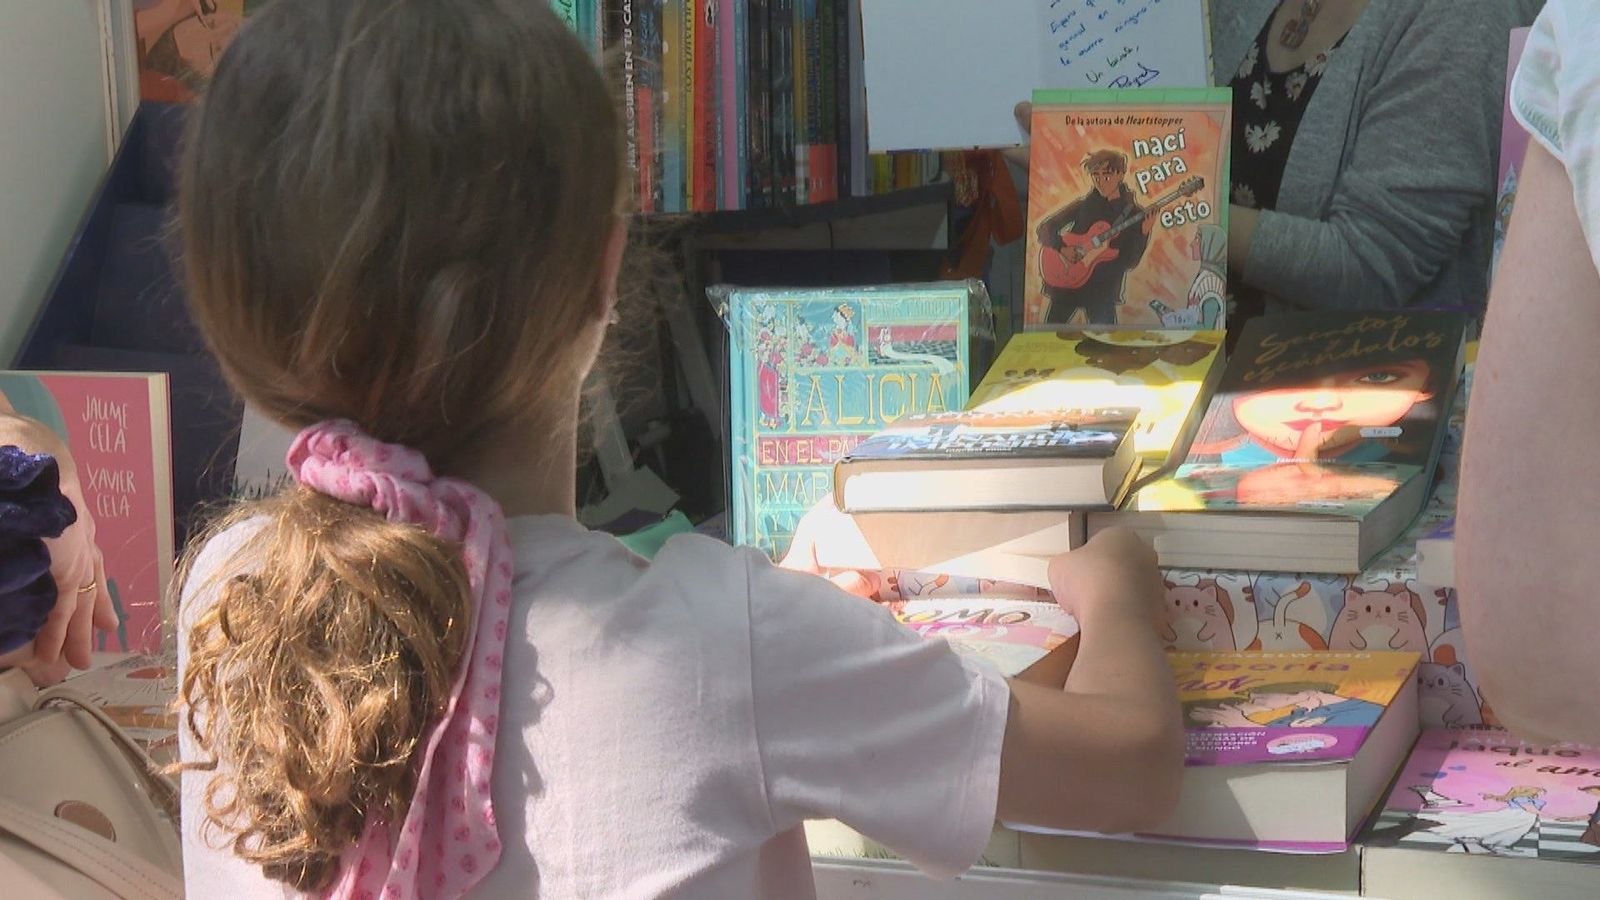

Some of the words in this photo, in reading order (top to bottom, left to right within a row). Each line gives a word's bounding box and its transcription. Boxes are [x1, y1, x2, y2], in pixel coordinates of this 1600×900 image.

[622, 0, 633, 26] CA
[623, 27, 633, 47] TU
[624, 50, 634, 71] EN
[625, 74, 636, 137] ALGUIEN
[1065, 115, 1076, 126] De
[1077, 115, 1084, 126] la
[1086, 116, 1112, 126] autora
[1113, 115, 1124, 125] de
[1125, 115, 1184, 127] Heartstopper
[1133, 128, 1186, 159] nací
[1135, 156, 1188, 194] para
[1160, 200, 1211, 229] esto
[82, 395, 129, 430] JAUME
[801, 372, 947, 426] ALICIA
[89, 423, 127, 454] CELA
[761, 440, 790, 464] EN
[797, 439, 822, 464] EL
[86, 463, 137, 495] XAVIER
[96, 494, 131, 518] CELA
